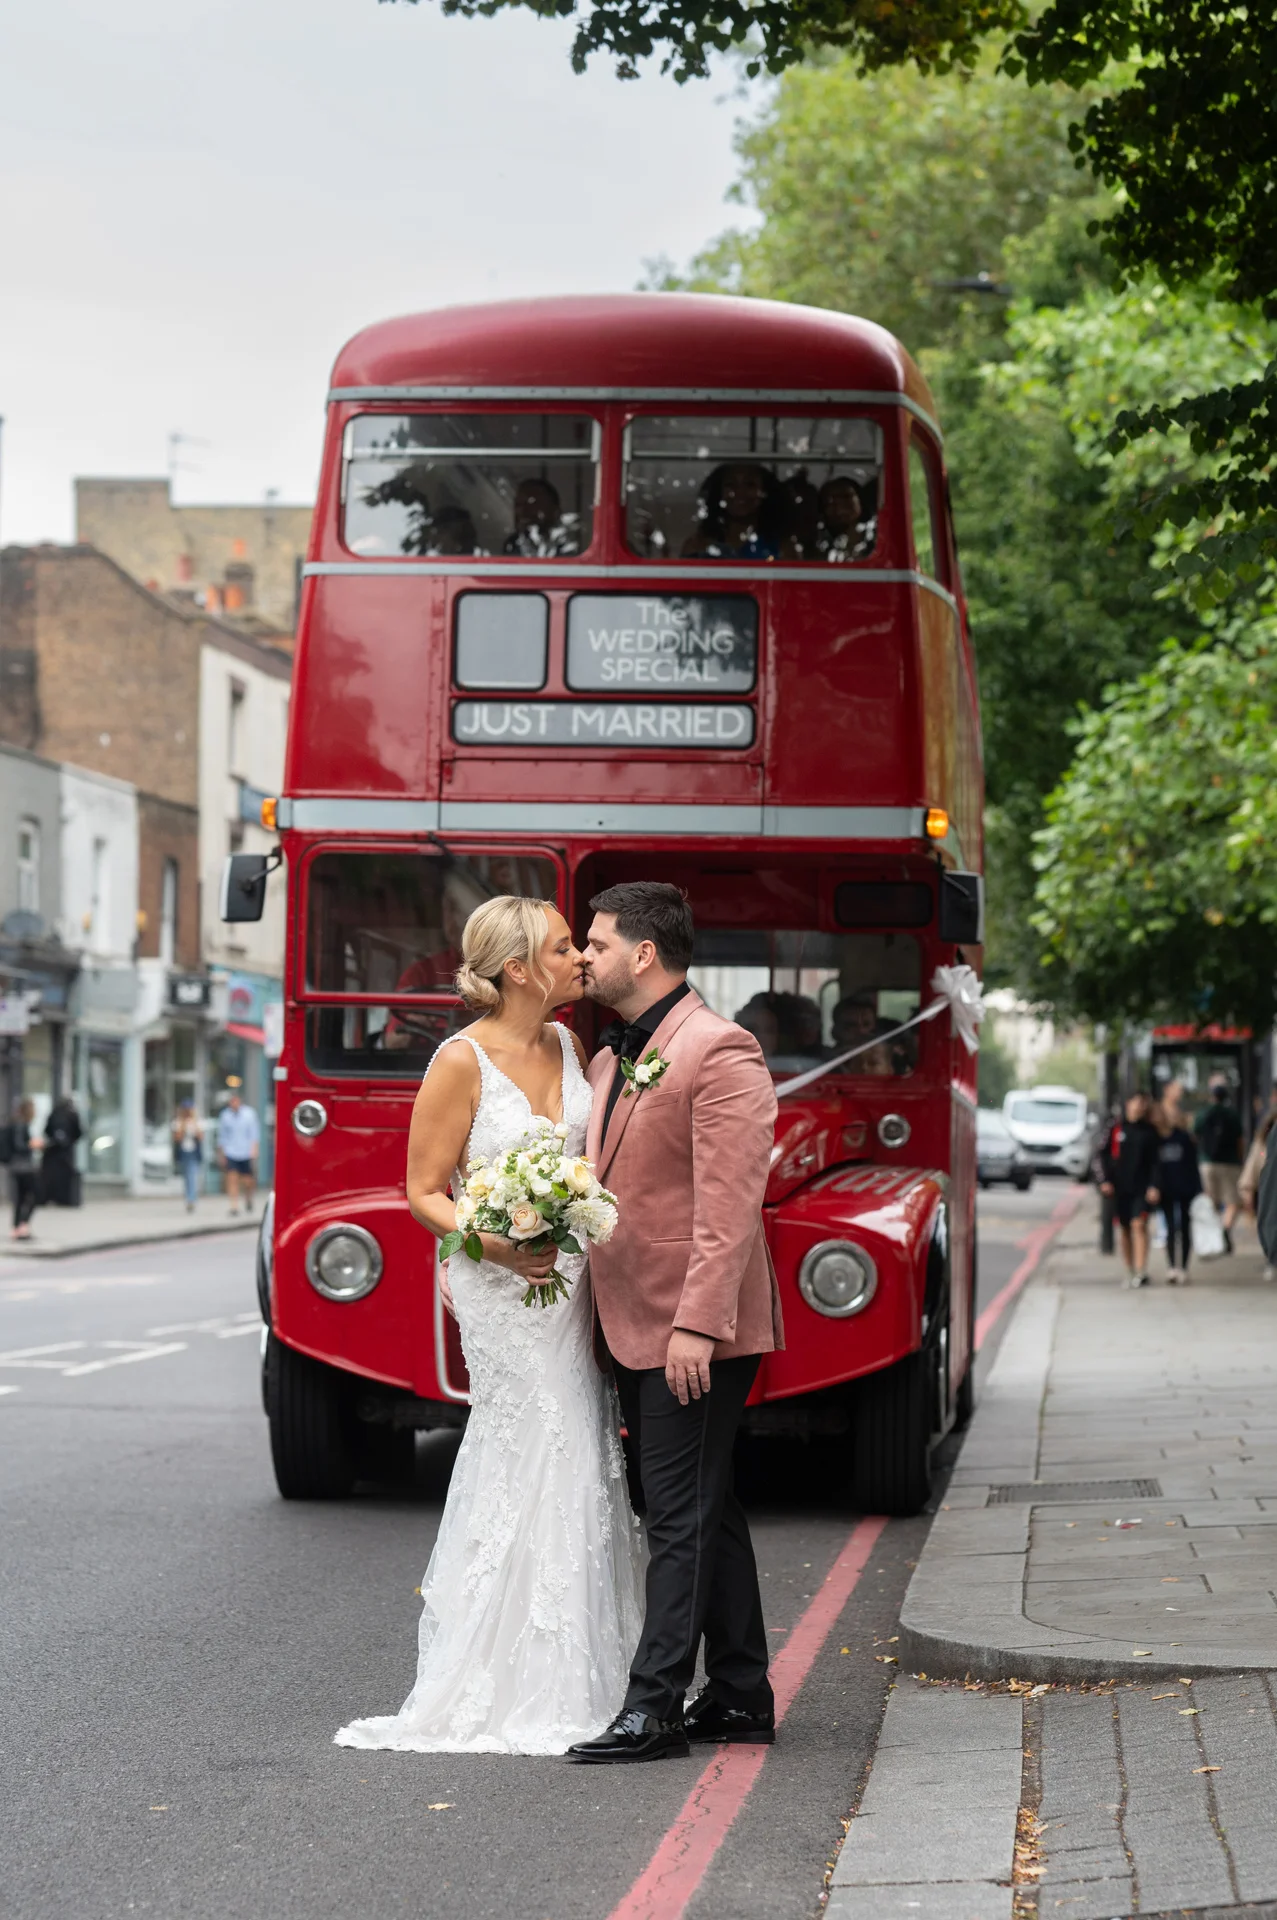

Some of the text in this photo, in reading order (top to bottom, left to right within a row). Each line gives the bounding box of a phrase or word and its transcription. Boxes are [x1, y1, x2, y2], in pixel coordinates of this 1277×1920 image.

[636, 601, 688, 626] The
[588, 628, 735, 654] WEDDING
[600, 657, 719, 683] SPECIAL
[461, 704, 745, 739] JUST MARRIED
